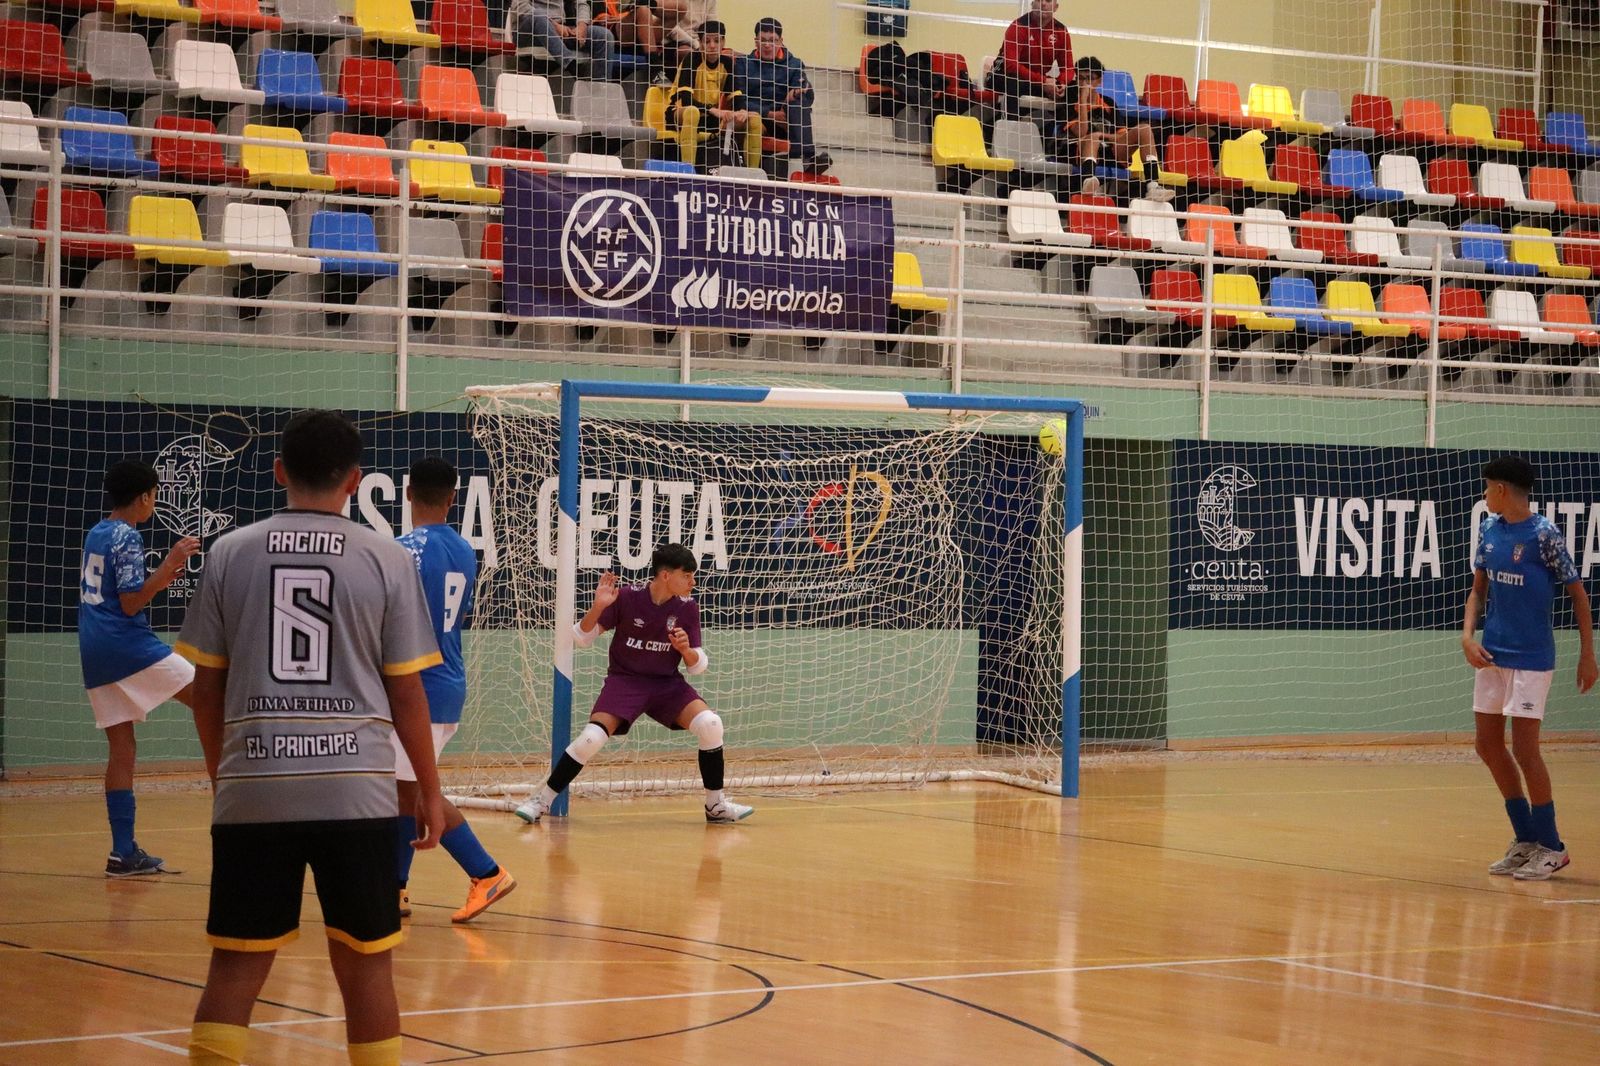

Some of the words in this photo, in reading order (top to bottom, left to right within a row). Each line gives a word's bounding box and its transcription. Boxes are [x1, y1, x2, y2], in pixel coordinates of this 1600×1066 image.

[706, 192, 840, 220] DIVISIÓN
[596, 226, 629, 246] RF
[705, 208, 784, 258] FÚTBOL
[791, 220, 847, 261] SALA
[593, 250, 629, 269] EF
[725, 279, 844, 315] Iberdrola
[267, 531, 345, 556] RACING
[1294, 496, 1441, 579] VISITA
[1187, 584, 1225, 592] SERVICIOS
[1226, 583, 1269, 592] TURÍSTICOS
[1496, 571, 1524, 586] CEUTI
[169, 589, 184, 598] DE
[443, 572, 467, 633] 9
[1209, 593, 1220, 601] DE
[1221, 593, 1246, 601] CEUTA
[268, 565, 333, 685] 6
[249, 697, 289, 712] DIMA
[293, 697, 355, 712] ETIHAD
[246, 736, 268, 759] EL
[273, 732, 359, 758] PRINCIPE
